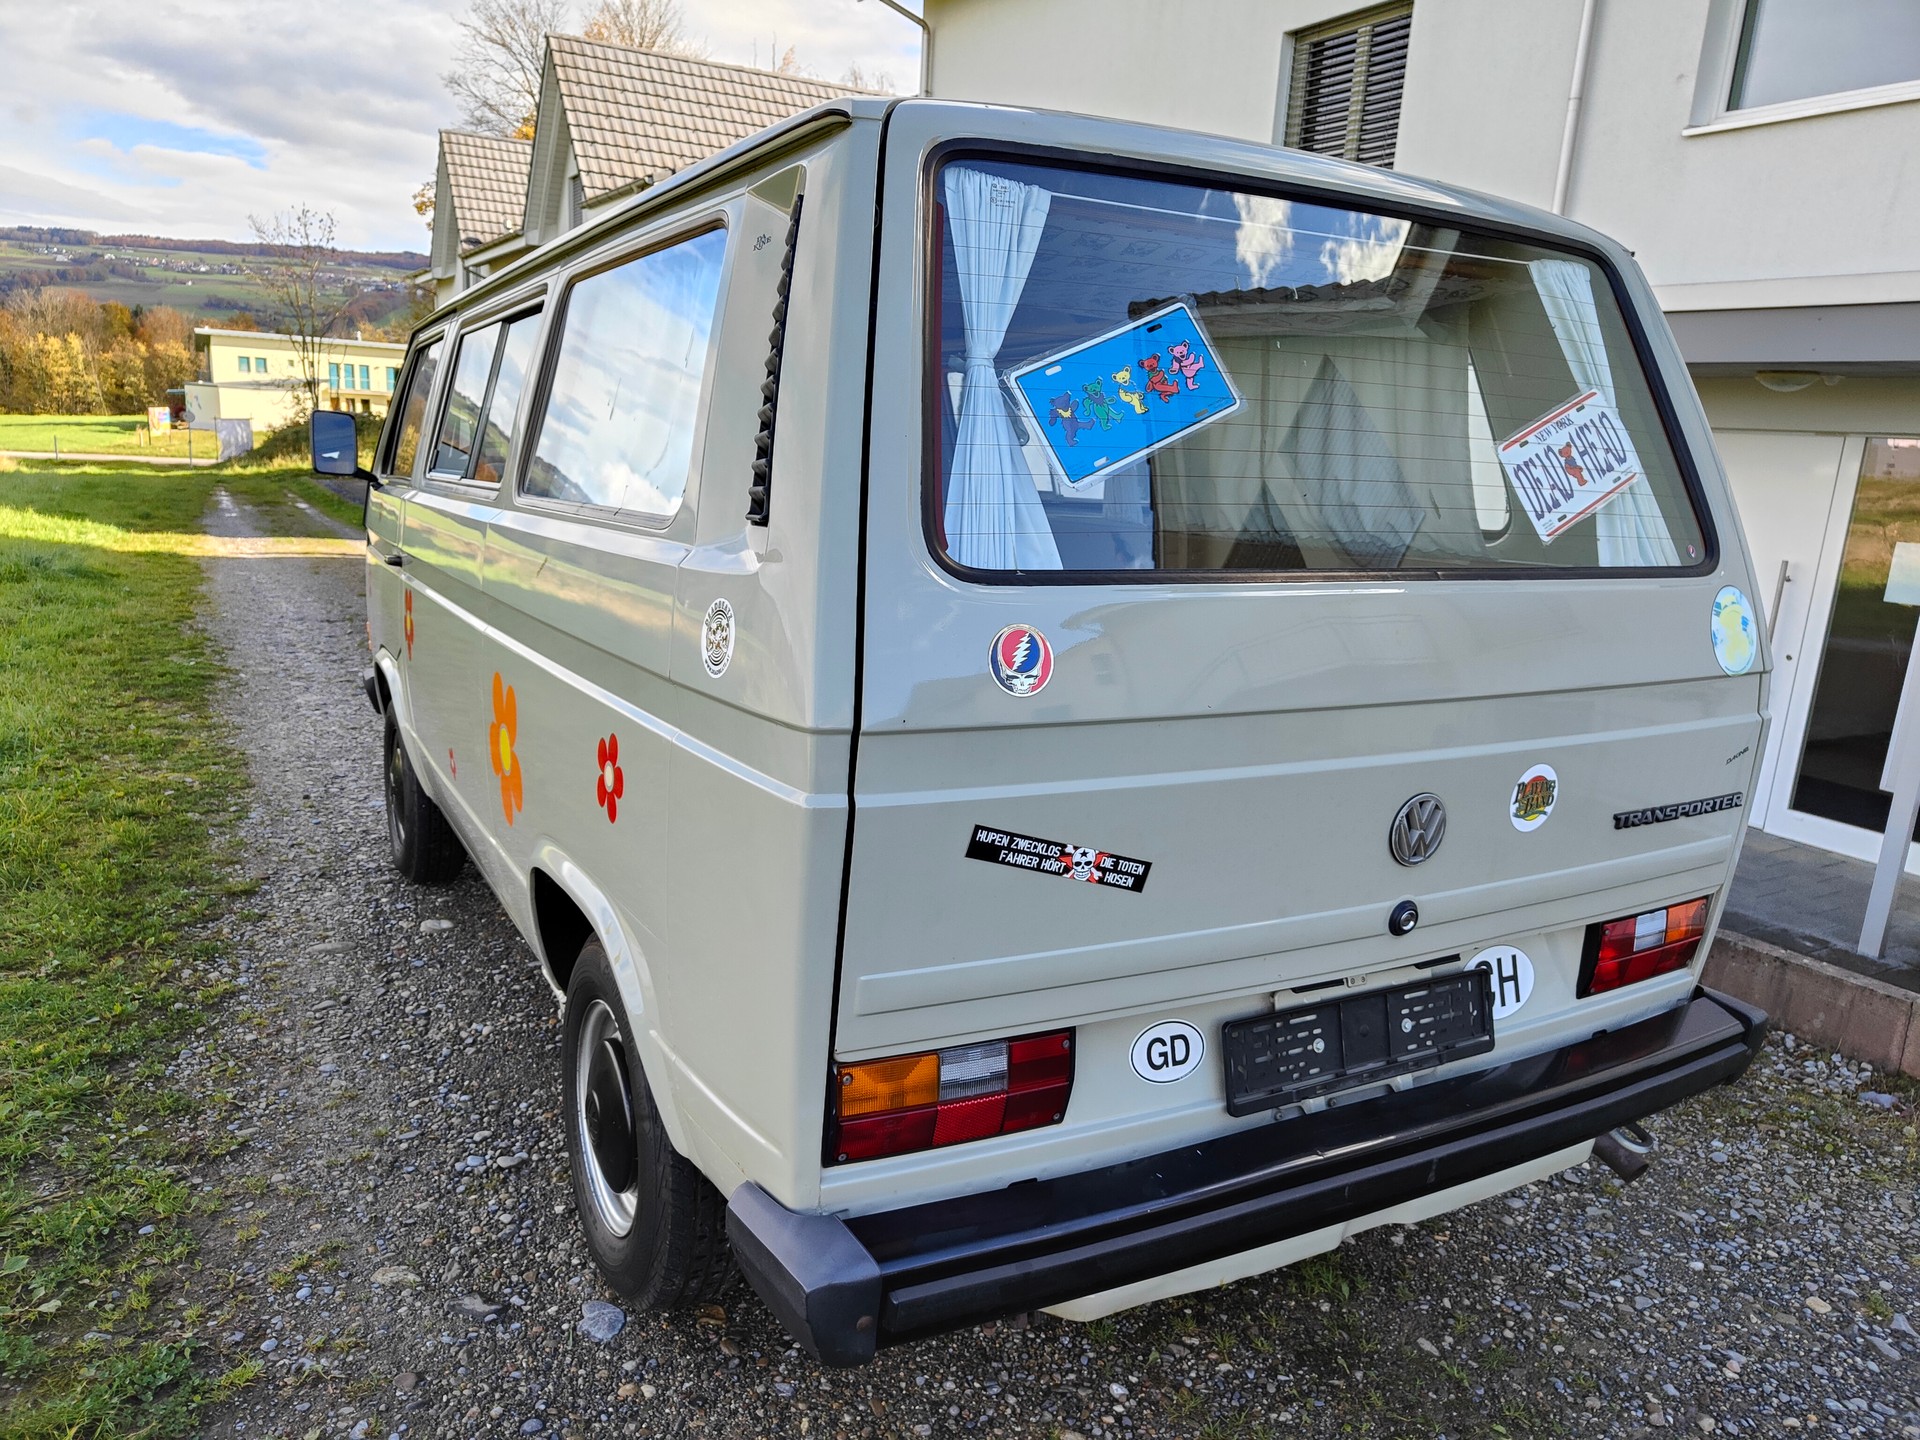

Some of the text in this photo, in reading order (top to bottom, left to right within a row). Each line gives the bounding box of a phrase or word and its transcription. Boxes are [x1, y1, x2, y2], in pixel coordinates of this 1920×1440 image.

[1534, 414, 1575, 444] NEW YORK
[1513, 411, 1627, 521] DEAD HEAD
[1725, 746, 1749, 765] DAKINE
[1513, 779, 1556, 805] PLAYING
[1524, 794, 1555, 815] BAND
[1613, 791, 1744, 830] TRANSPORTER
[976, 829, 1062, 857] HUPEN ZWECKLOS
[999, 850, 1067, 874] FAHRER HÖRT
[1100, 856, 1146, 876] DIE TOTEN
[1104, 871, 1135, 888] HOSEN
[1474, 954, 1520, 1007] H
[1147, 1034, 1190, 1071] GD
